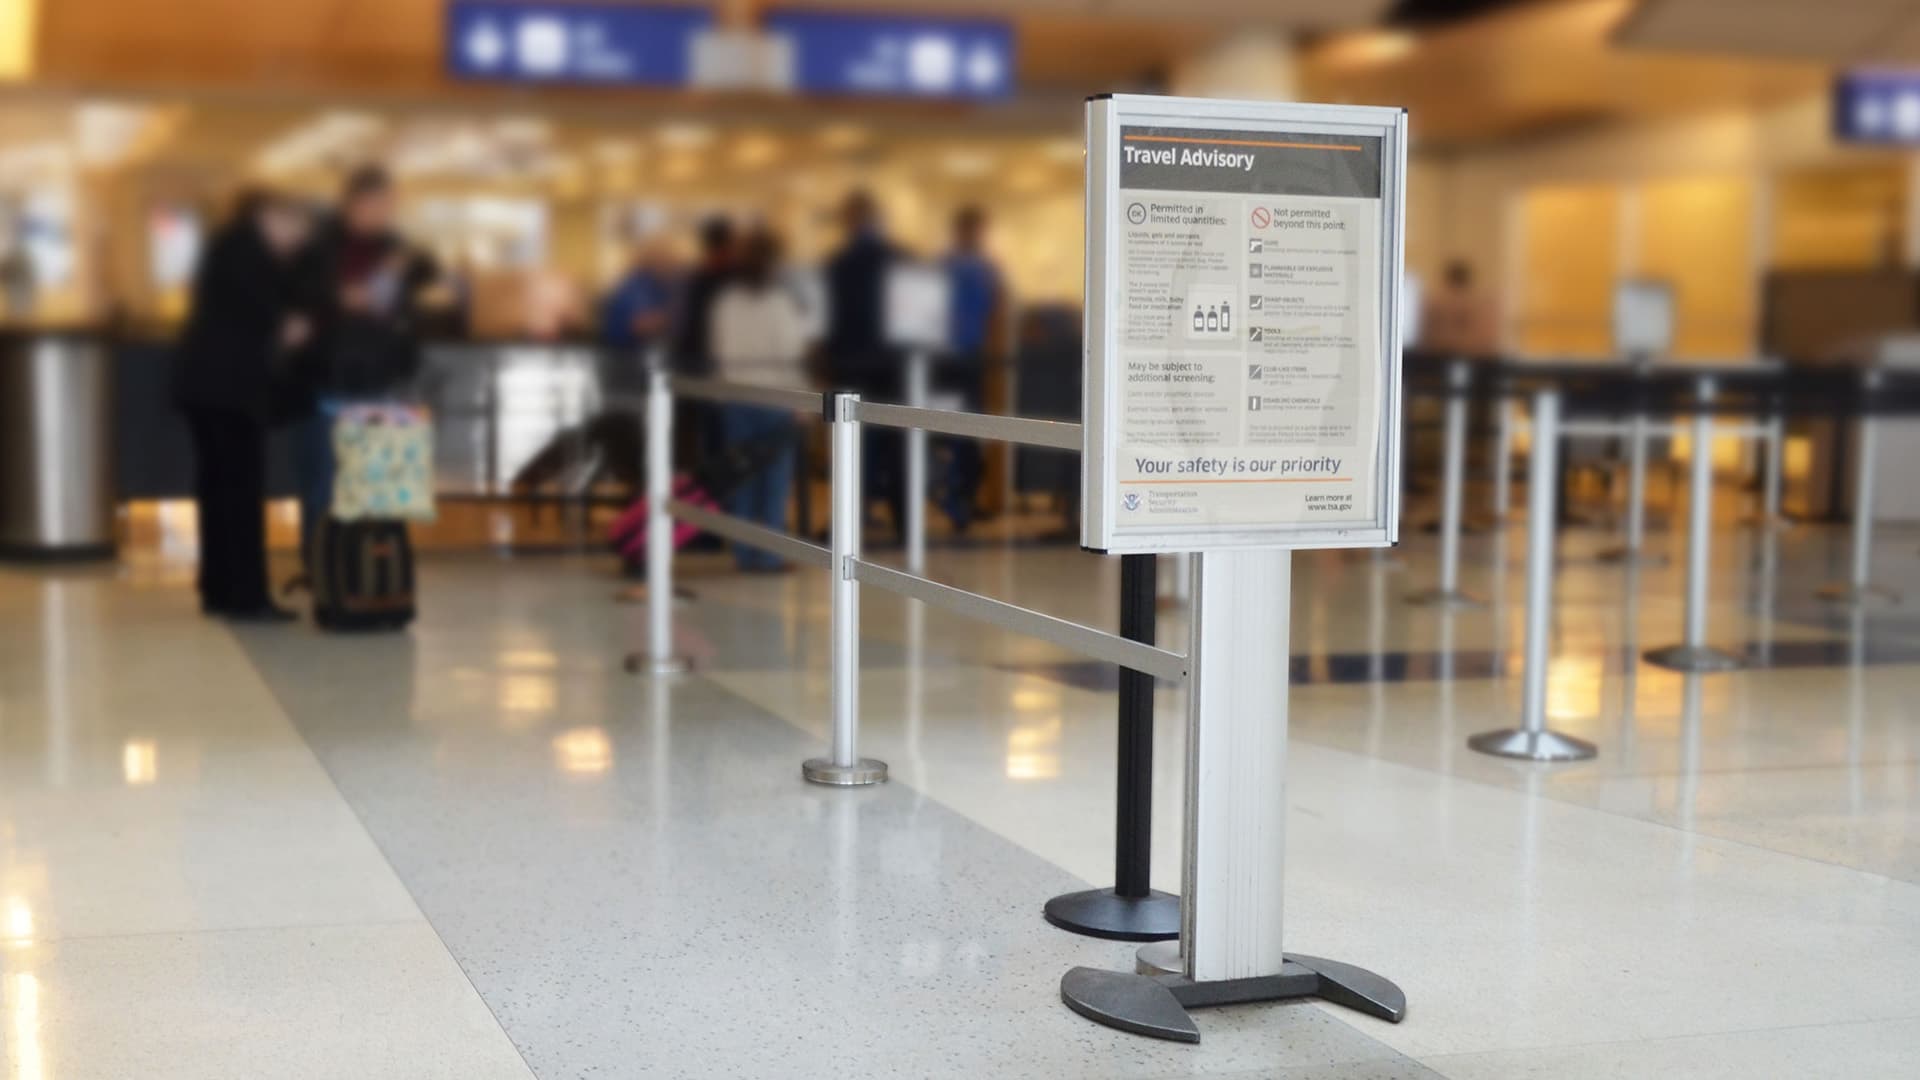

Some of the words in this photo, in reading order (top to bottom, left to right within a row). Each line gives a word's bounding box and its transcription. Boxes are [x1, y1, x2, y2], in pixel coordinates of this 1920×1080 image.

[1123, 146, 1176, 165] Travel
[1180, 149, 1255, 171] Advisory
[1150, 203, 1193, 214] Permitted
[1195, 204, 1204, 214] in
[1273, 208, 1288, 217] Not
[1290, 208, 1331, 218] permitted
[1150, 214, 1181, 224] limited
[1182, 215, 1226, 225] quantities:
[1273, 220, 1304, 230] beyond
[1306, 220, 1321, 229] this
[1127, 362, 1147, 372] May
[1149, 362, 1159, 371] be
[1161, 362, 1192, 372] subject
[1193, 362, 1203, 371] to
[1127, 373, 1171, 383] additional
[1135, 458, 1172, 473] Your
[1177, 457, 1228, 476] safety
[1232, 457, 1245, 473] is
[1249, 459, 1277, 473] our
[1281, 456, 1341, 476] priority
[1305, 494, 1324, 502] Learn
[1308, 503, 1352, 512] www.tsa.gov
